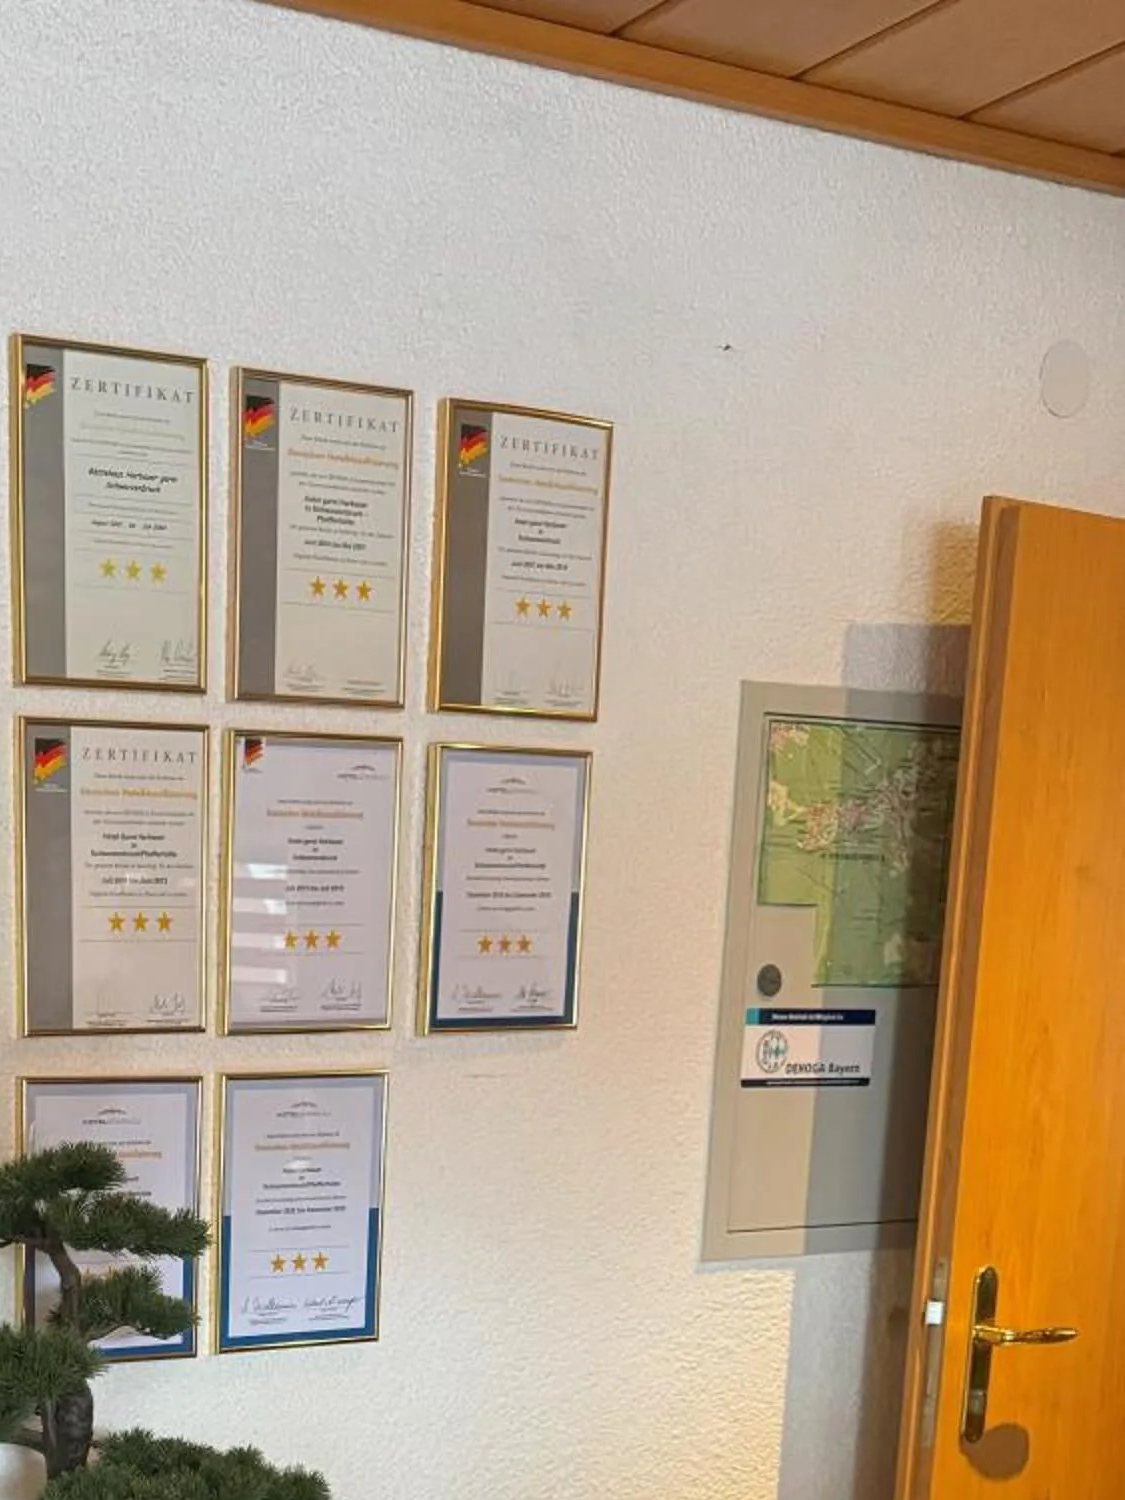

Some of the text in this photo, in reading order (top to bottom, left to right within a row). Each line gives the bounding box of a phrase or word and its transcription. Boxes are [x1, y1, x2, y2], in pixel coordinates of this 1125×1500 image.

[70, 376, 195, 403] ZERTIFIKAT
[290, 405, 398, 433] ZERTIFIKAT
[499, 434, 598, 460] ZERTIFIKAT
[82, 746, 197, 763] ZERTIFIKAT
[829, 1062, 860, 1075] Bayern
